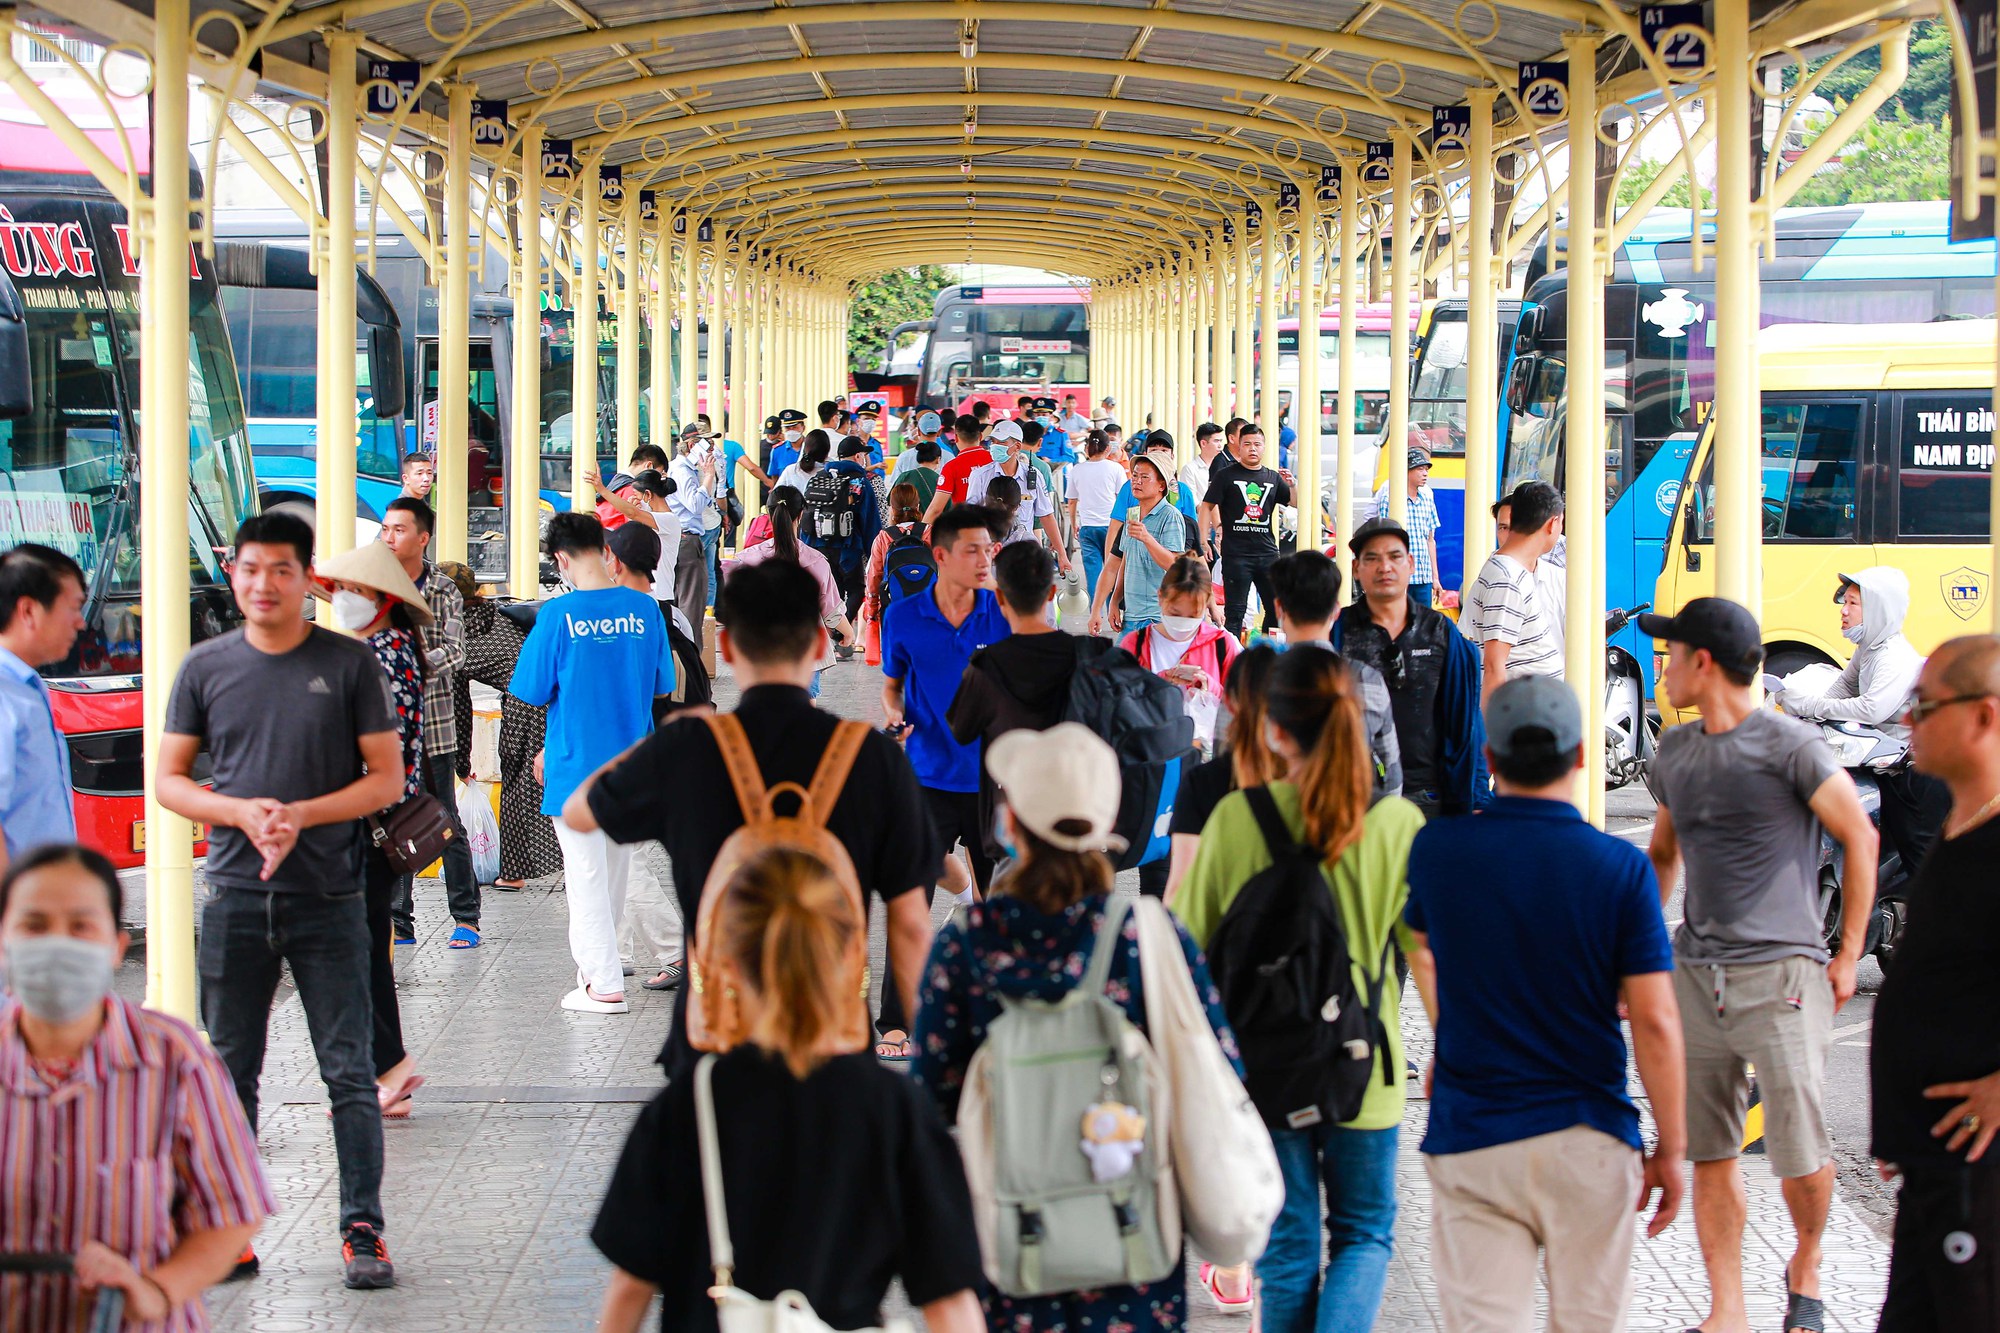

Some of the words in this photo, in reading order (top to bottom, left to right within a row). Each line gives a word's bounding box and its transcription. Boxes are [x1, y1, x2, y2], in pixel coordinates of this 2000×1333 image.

[1645, 10, 1663, 25] A1
[1653, 28, 1700, 62] 22
[373, 65, 389, 77] A2
[1523, 65, 1537, 78] A1
[378, 81, 414, 109] 05
[1529, 84, 1563, 110] 23
[1436, 107, 1448, 119] A1
[1369, 145, 1381, 154] A1
[542, 154, 568, 173] 07
[1328, 179, 1340, 196] 2
[23, 288, 58, 308] THANH
[1917, 408, 1961, 432] THÁI
[1966, 408, 1997, 432] BÌN
[1914, 445, 1961, 466] NAM
[1966, 445, 1996, 469] ĐỊN
[565, 612, 645, 639] levents
